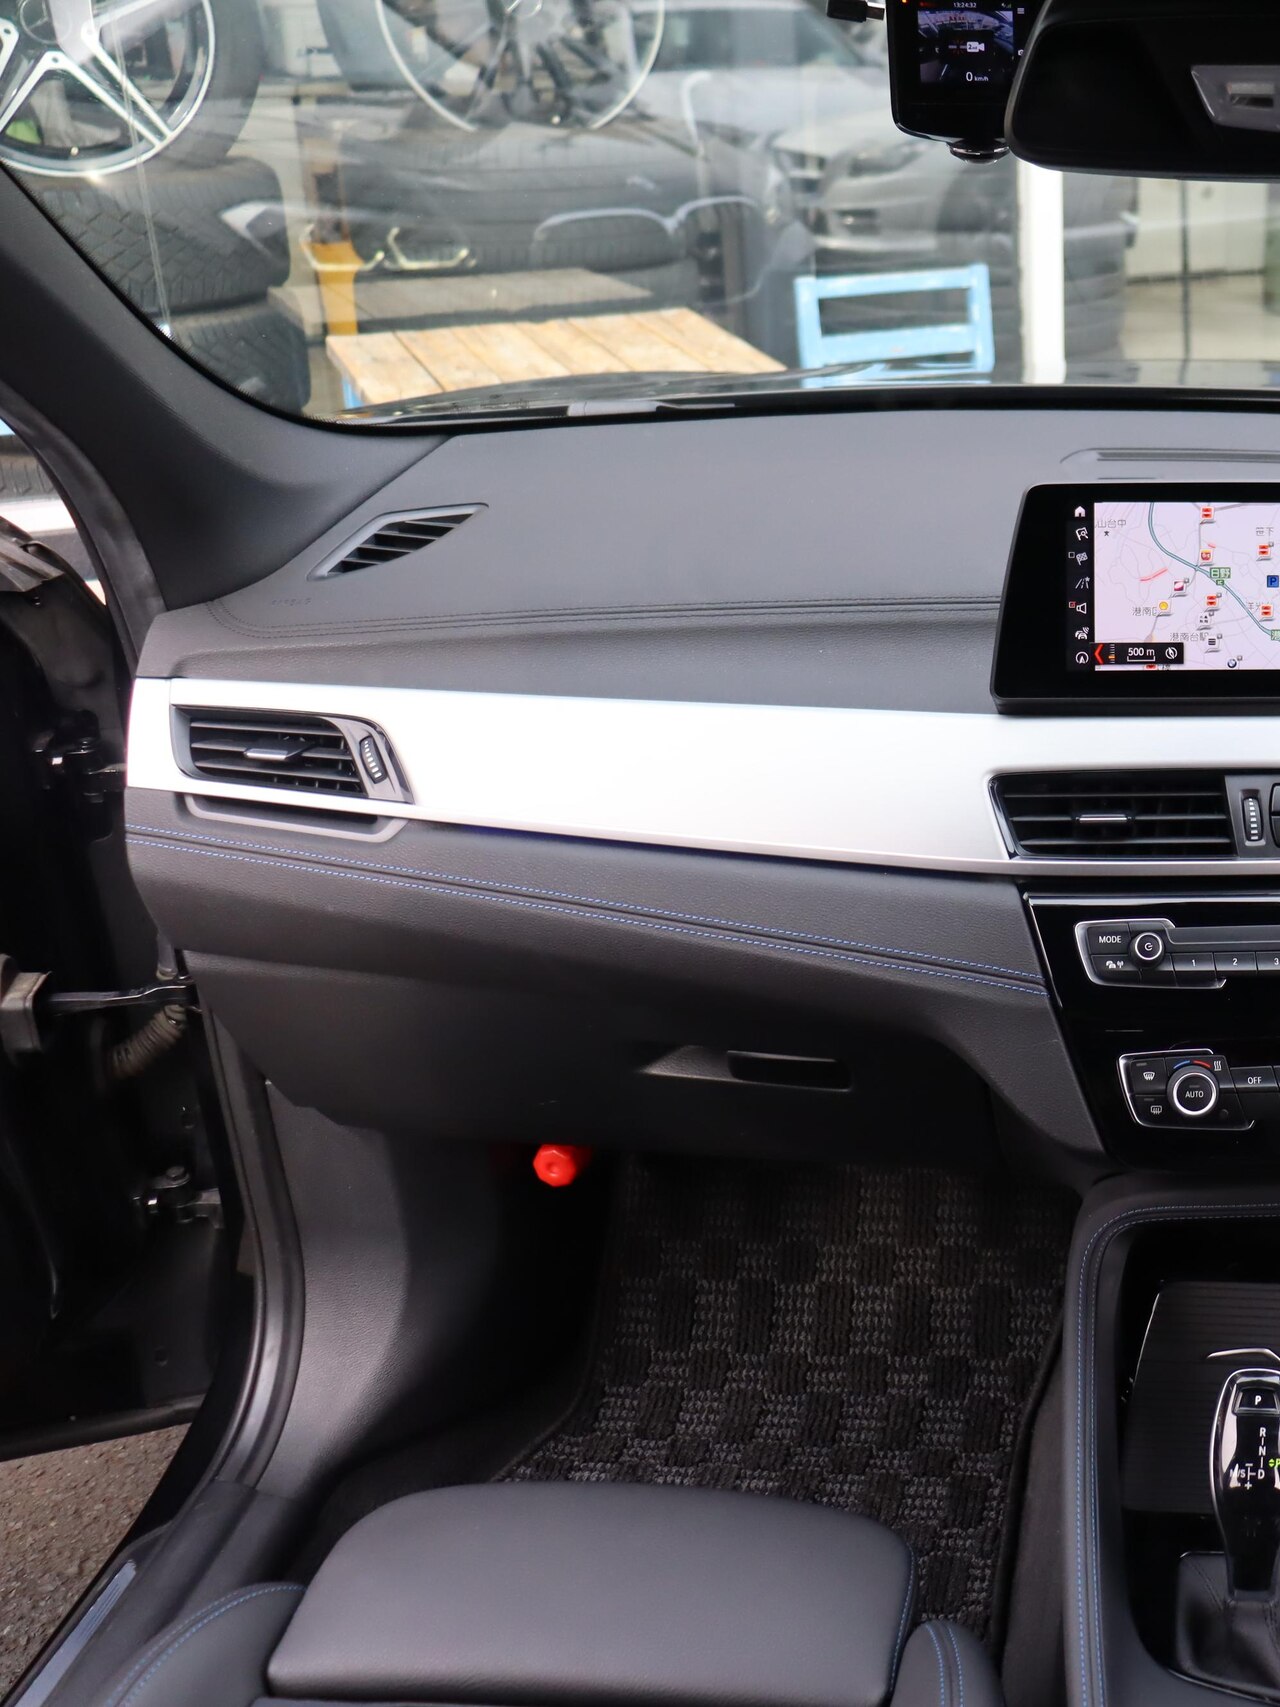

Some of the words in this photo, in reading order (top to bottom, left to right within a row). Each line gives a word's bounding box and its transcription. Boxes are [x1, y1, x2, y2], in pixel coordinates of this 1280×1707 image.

[966, 72, 973, 82] 0
[1095, 519, 1126, 528] 山台中
[1128, 648, 1144, 656] 500
[1098, 936, 1122, 944] MODE
[1247, 1076, 1262, 1085] OFF
[1255, 1395, 1262, 1405] P
[1259, 1427, 1266, 1437] R
[1259, 1446, 1266, 1456] N
[1258, 1469, 1265, 1479] D
